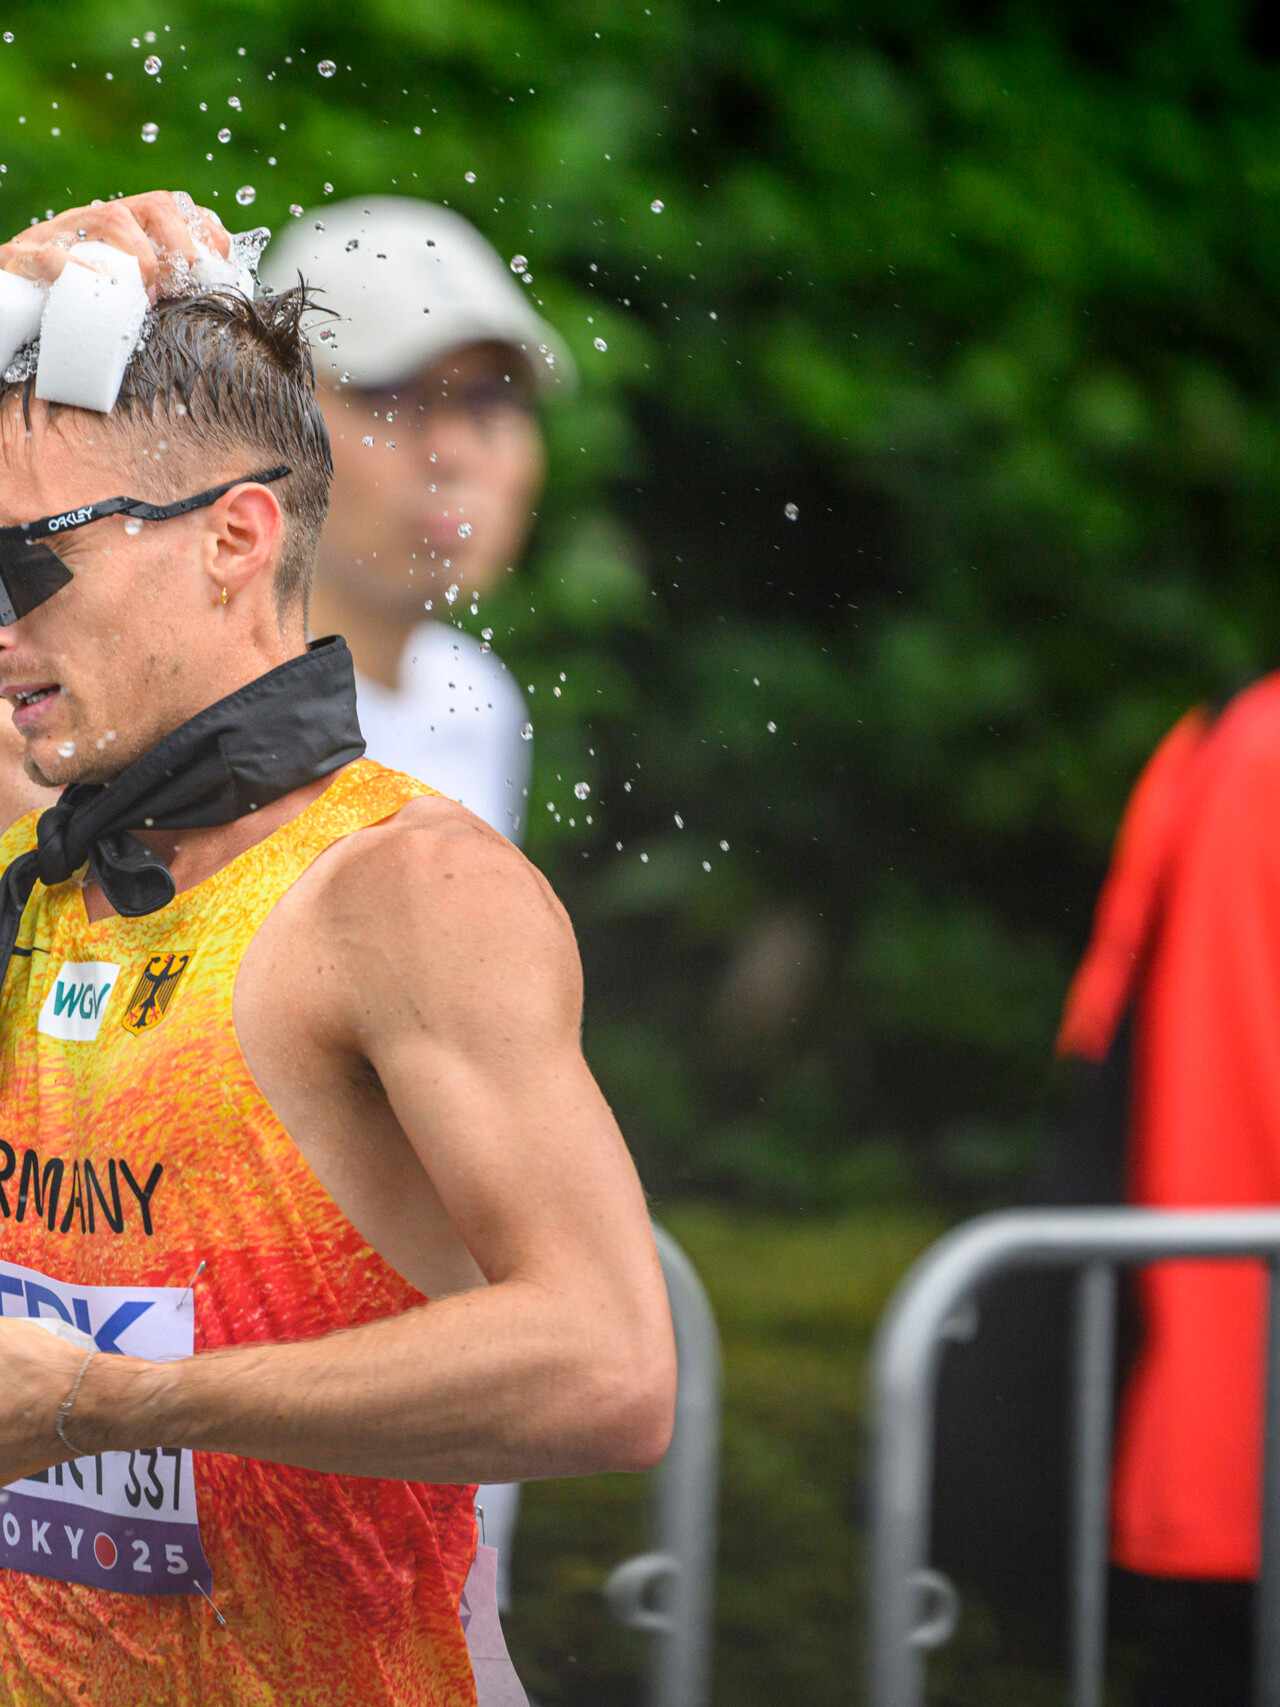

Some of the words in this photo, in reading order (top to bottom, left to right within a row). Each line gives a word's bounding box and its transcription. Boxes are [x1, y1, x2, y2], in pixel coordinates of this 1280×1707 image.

[48, 506, 93, 532] OAKLEY
[53, 980, 111, 1020] WGV
[124, 1447, 183, 1511] 337
[131, 1539, 189, 1575] 25
